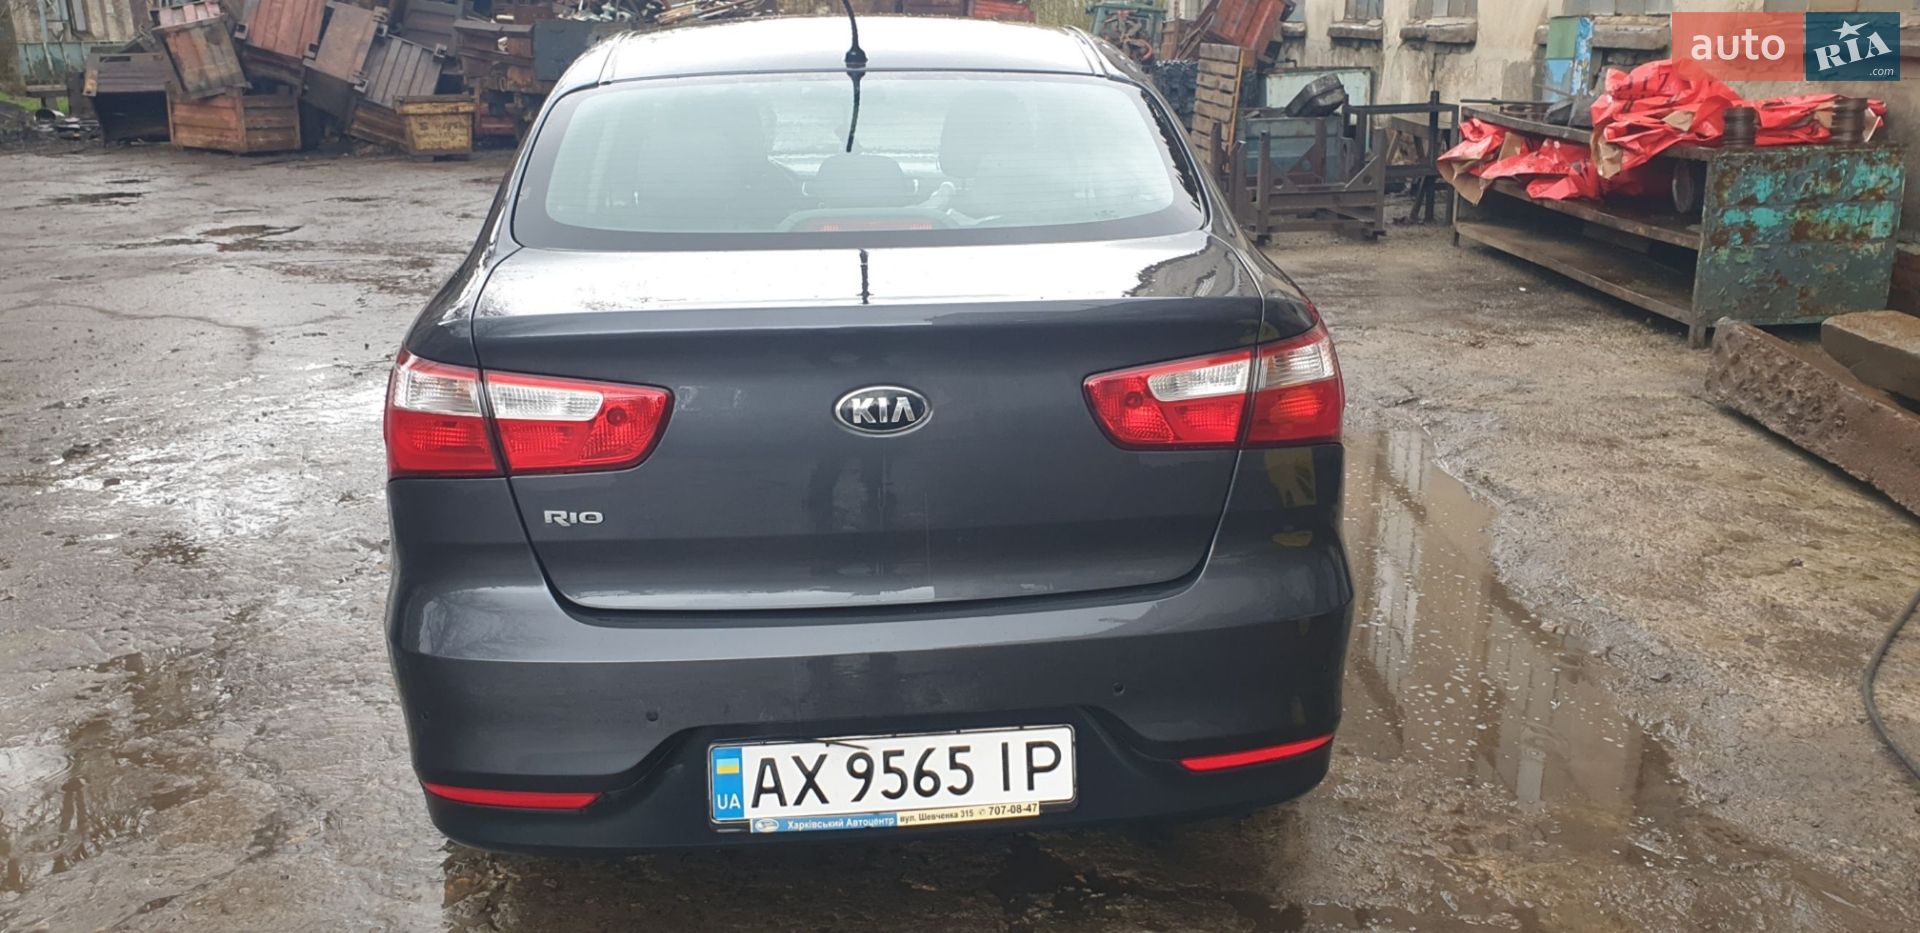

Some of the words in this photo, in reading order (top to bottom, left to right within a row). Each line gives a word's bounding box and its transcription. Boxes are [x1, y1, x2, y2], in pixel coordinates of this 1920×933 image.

[851, 397, 916, 425] KIA
[544, 510, 604, 527] RIO
[751, 753, 830, 808] AX
[846, 745, 975, 803] 9565
[1001, 740, 1062, 792] IP
[717, 792, 741, 811] UA
[787, 817, 844, 831] Харківський
[845, 816, 895, 830] Автоцентр
[960, 809, 974, 818] 315
[988, 803, 1037, 816] 707-08-47
